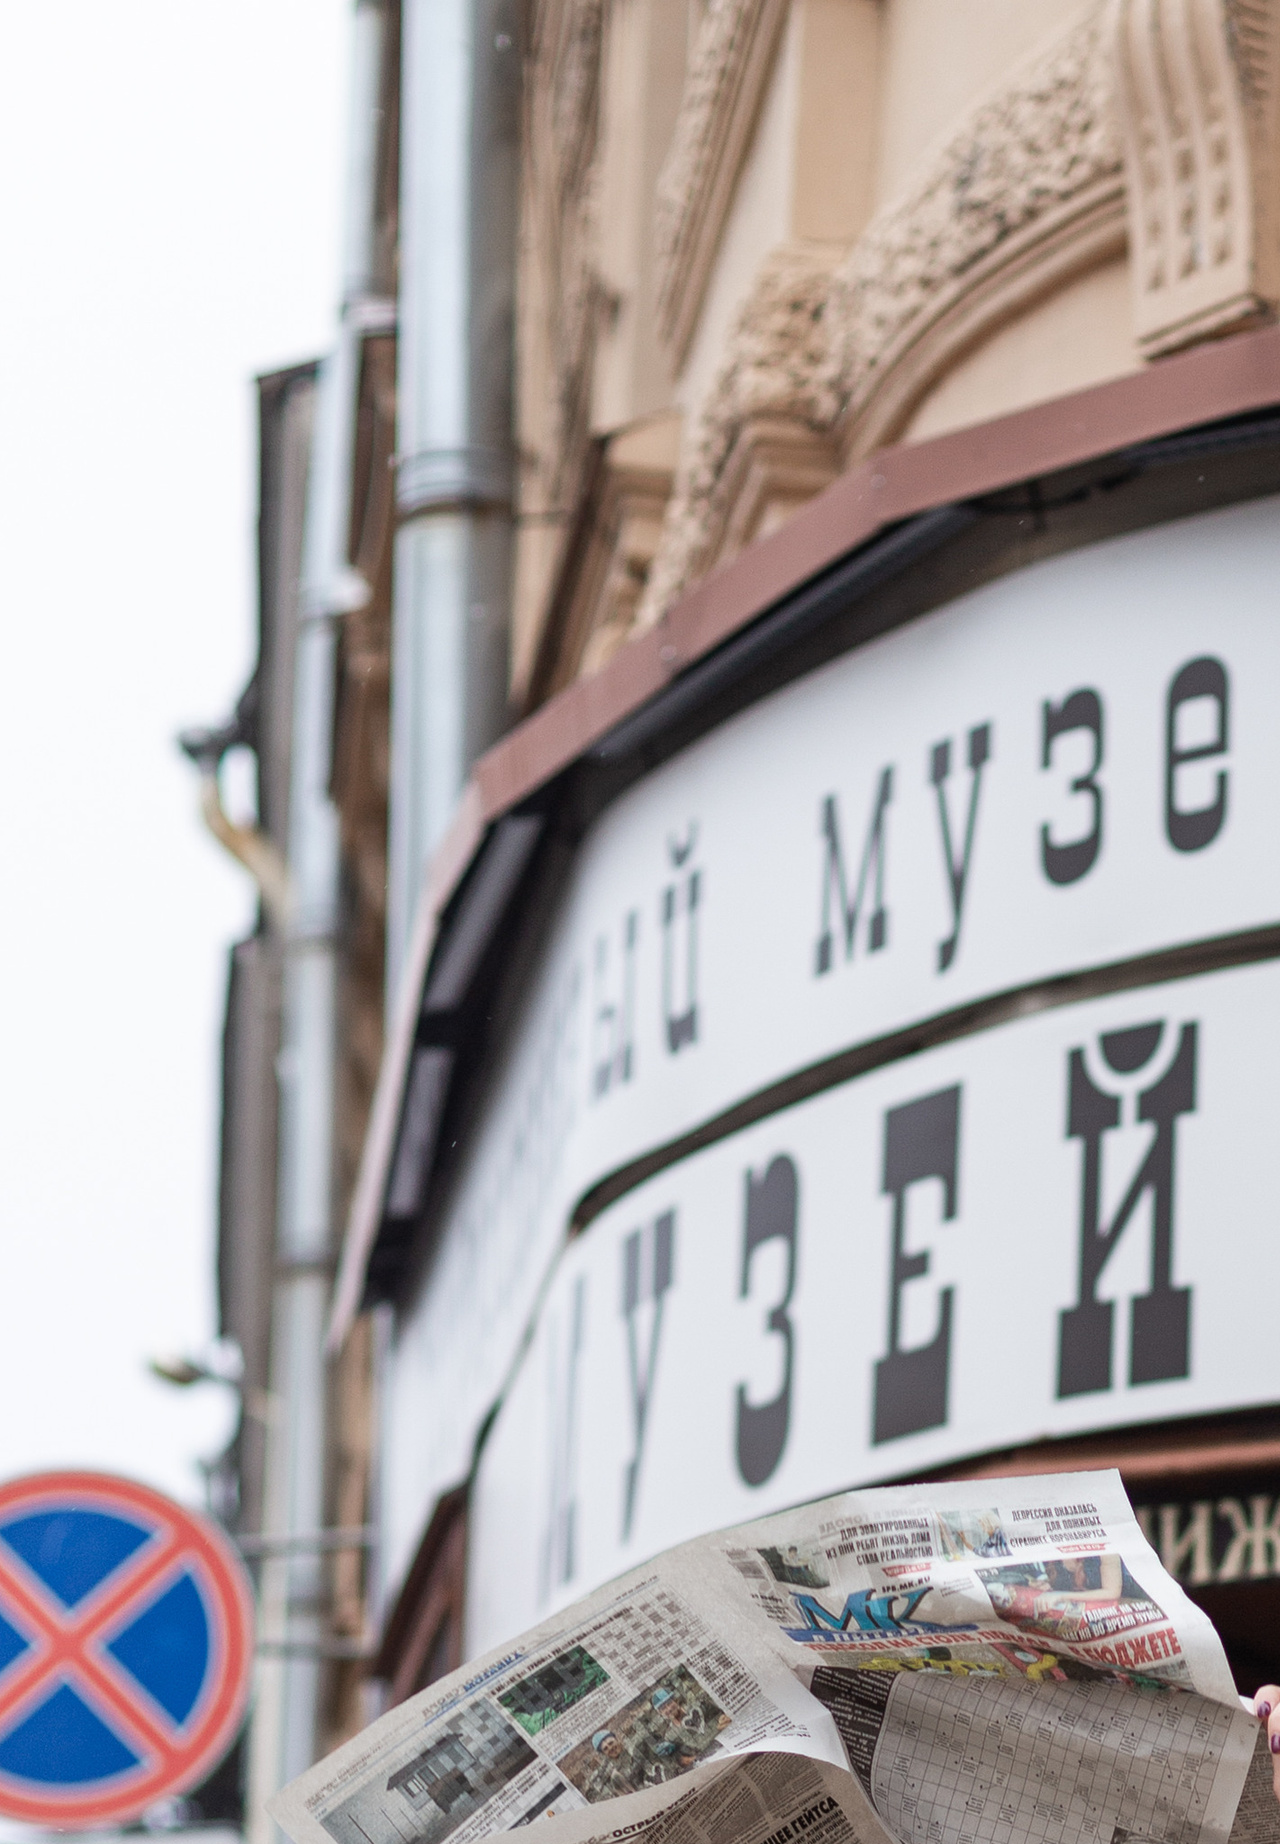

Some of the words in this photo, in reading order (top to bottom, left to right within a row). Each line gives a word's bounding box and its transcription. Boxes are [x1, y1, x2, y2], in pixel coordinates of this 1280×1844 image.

[1012, 1507, 1053, 1521] ДЕПРЕССИЯ
[1055, 1503, 1097, 1517] ОКАЗАЛАСЬ
[1045, 1520, 1062, 1533] ДЛЯ
[1063, 1516, 1102, 1530] ПОЖИЛЫХ
[840, 1526, 858, 1541] ДЛЯ
[860, 1518, 929, 1535] ЭВАКУИРОВАННЫХ
[1010, 1536, 1049, 1548] СТРАШНЕЕ
[1050, 1528, 1107, 1543] КОРОНАВИРУСА
[825, 1548, 837, 1559] ИЗ
[840, 1542, 855, 1555] ПНИ
[857, 1538, 879, 1552] РЕБЯТ
[881, 1534, 909, 1547] ЖИЗНЬ
[911, 1531, 931, 1543] ДОМА
[856, 1552, 879, 1566] СТАЛА
[881, 1546, 933, 1562] РЕАЛЬНОСТЬЮ
[789, 1586, 933, 1631] МК
[1093, 1621, 1106, 1637] ВО
[1106, 1615, 1137, 1632] ВРЕМЯ
[1136, 1609, 1164, 1624] ЧУМЫ
[612, 1809, 665, 1838] ОСТРЫЙ
[790, 1796, 839, 1834] ГЕЙТСА
[804, 1809, 844, 1838] изменения
[824, 1815, 848, 1835] войны
